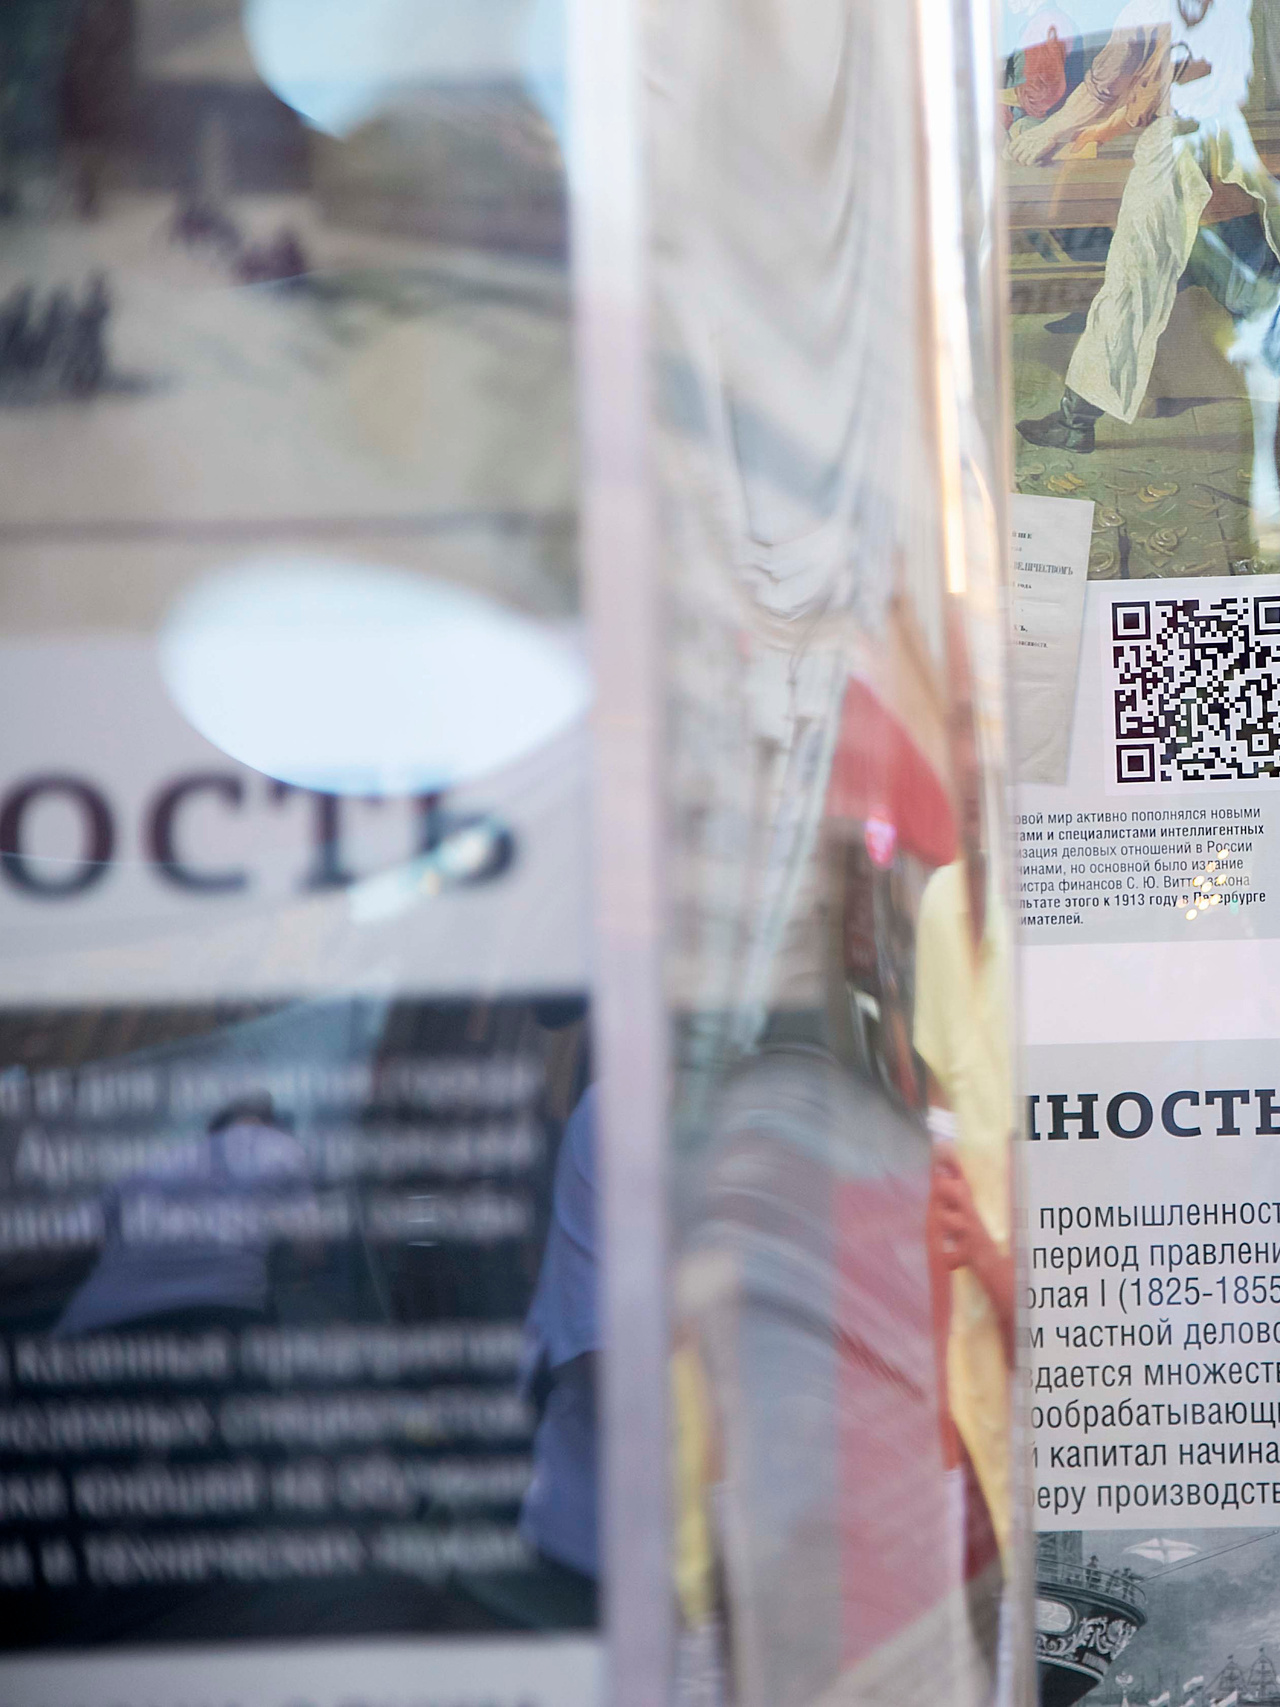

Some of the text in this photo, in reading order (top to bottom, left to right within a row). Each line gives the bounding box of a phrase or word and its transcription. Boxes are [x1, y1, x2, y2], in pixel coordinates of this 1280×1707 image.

[1048, 813, 1073, 826] мир
[1076, 811, 1127, 824] активно
[1131, 809, 1206, 822] пополнялся
[1211, 808, 1261, 819] новыми
[1047, 831, 1054, 840] и
[1058, 828, 1156, 841] специалистами
[1160, 825, 1264, 838] интеллигентных
[1062, 846, 1117, 859] деловых
[1121, 842, 1192, 855] отношений
[1196, 844, 1203, 853] в
[1207, 840, 1253, 854] России
[1070, 864, 1085, 874] но
[1089, 860, 1150, 874] основной
[1154, 859, 1188, 872] было
[1058, 879, 1123, 893] финансов
[1127, 876, 1139, 889] С.
[1143, 876, 1159, 888] Ю.
[1065, 897, 1099, 908] этого
[1103, 896, 1110, 906] к
[1114, 893, 1145, 907] 1913
[1149, 894, 1178, 908] году
[1182, 894, 1189, 904] в
[1033, 1245, 1139, 1276] период
[1056, 1318, 1172, 1348] частной
[1050, 1443, 1167, 1469] капитал
[1032, 1485, 1086, 1516] еру
